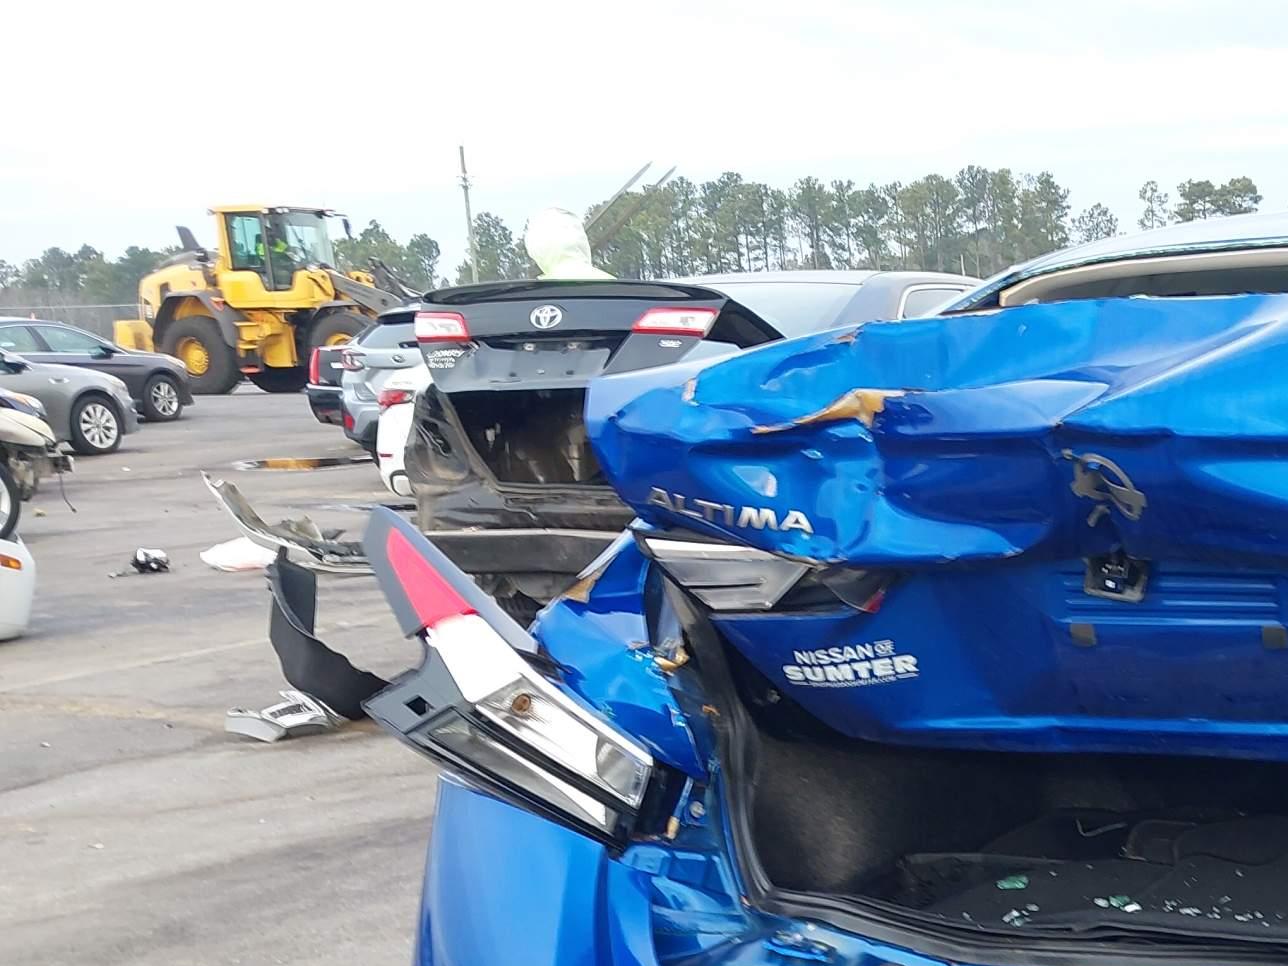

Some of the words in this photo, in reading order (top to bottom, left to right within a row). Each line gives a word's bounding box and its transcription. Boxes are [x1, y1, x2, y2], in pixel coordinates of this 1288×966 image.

[648, 486, 814, 534] ALTIMA
[793, 643, 875, 665] NISSAN
[782, 655, 920, 682] SUMTER
